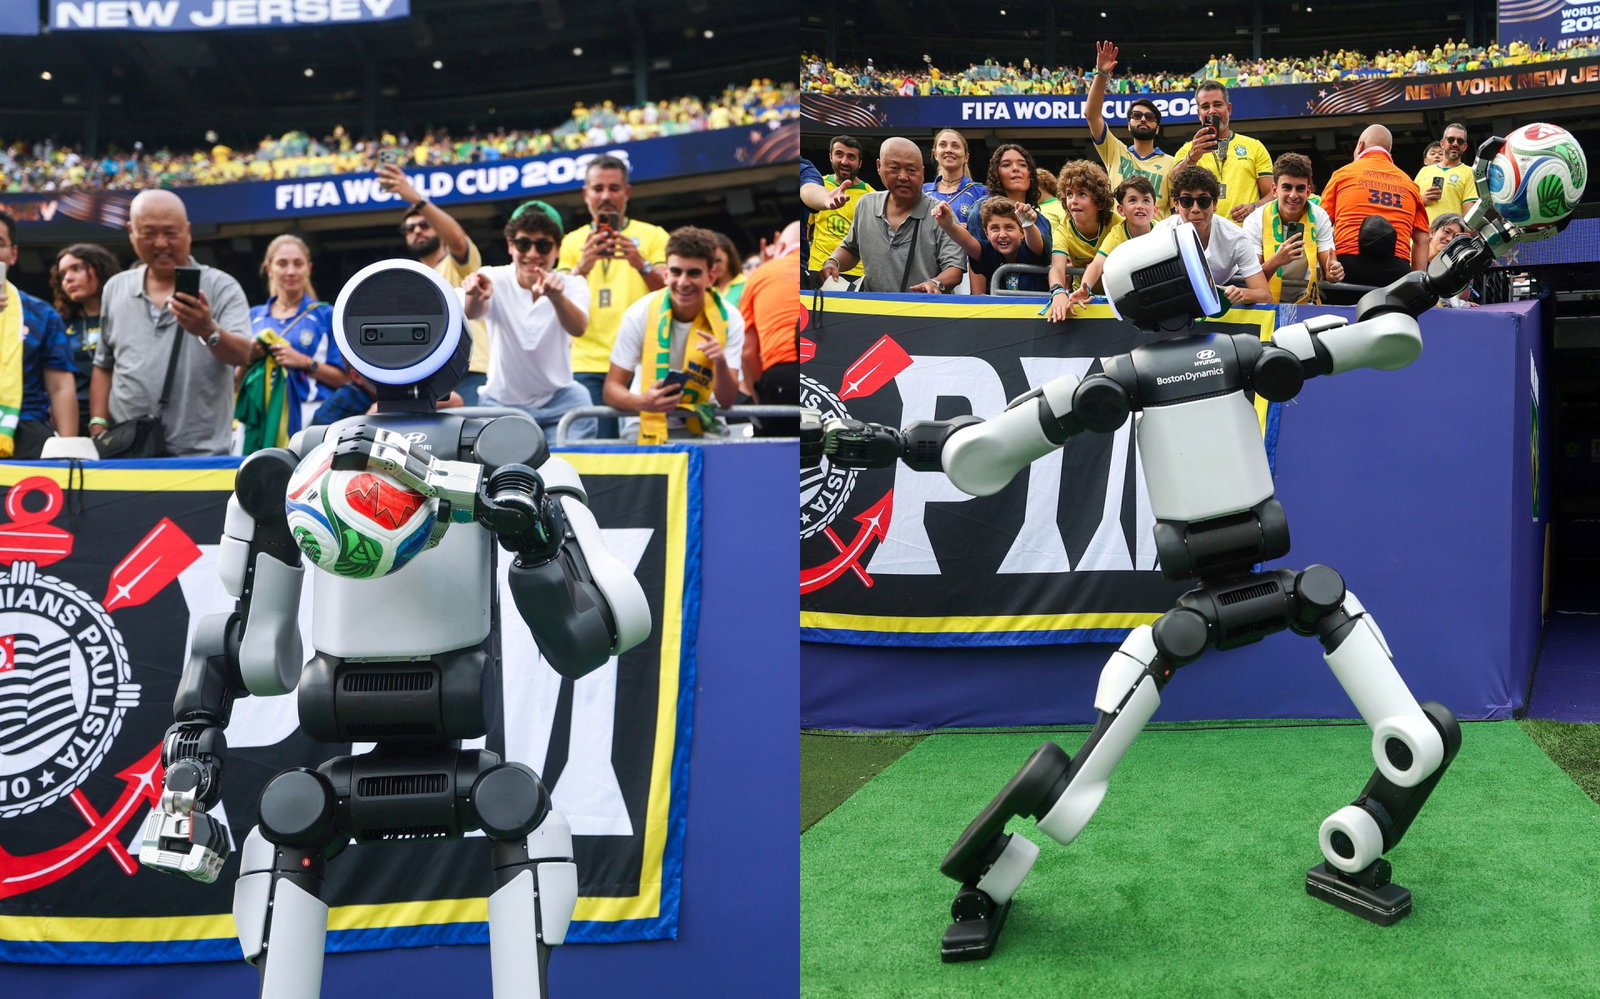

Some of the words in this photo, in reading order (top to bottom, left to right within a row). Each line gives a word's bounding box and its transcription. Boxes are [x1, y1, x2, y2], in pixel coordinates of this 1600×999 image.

[56, 1, 181, 28] NEW
[189, 0, 395, 27] JERSEY
[1405, 82, 1453, 101] NEW
[1456, 74, 1513, 96] YORK
[1517, 68, 1568, 89] NEW
[962, 102, 1011, 120] FIFA
[1015, 100, 1086, 119] WORL
[1101, 100, 1134, 119] CU
[275, 181, 341, 210] FIFA
[342, 171, 455, 204] WOLD
[456, 164, 519, 195] CUP
[1367, 188, 1403, 209] 381
[1194, 357, 1222, 366] HYUNDAI
[55, 624, 114, 770] PAULISTA
